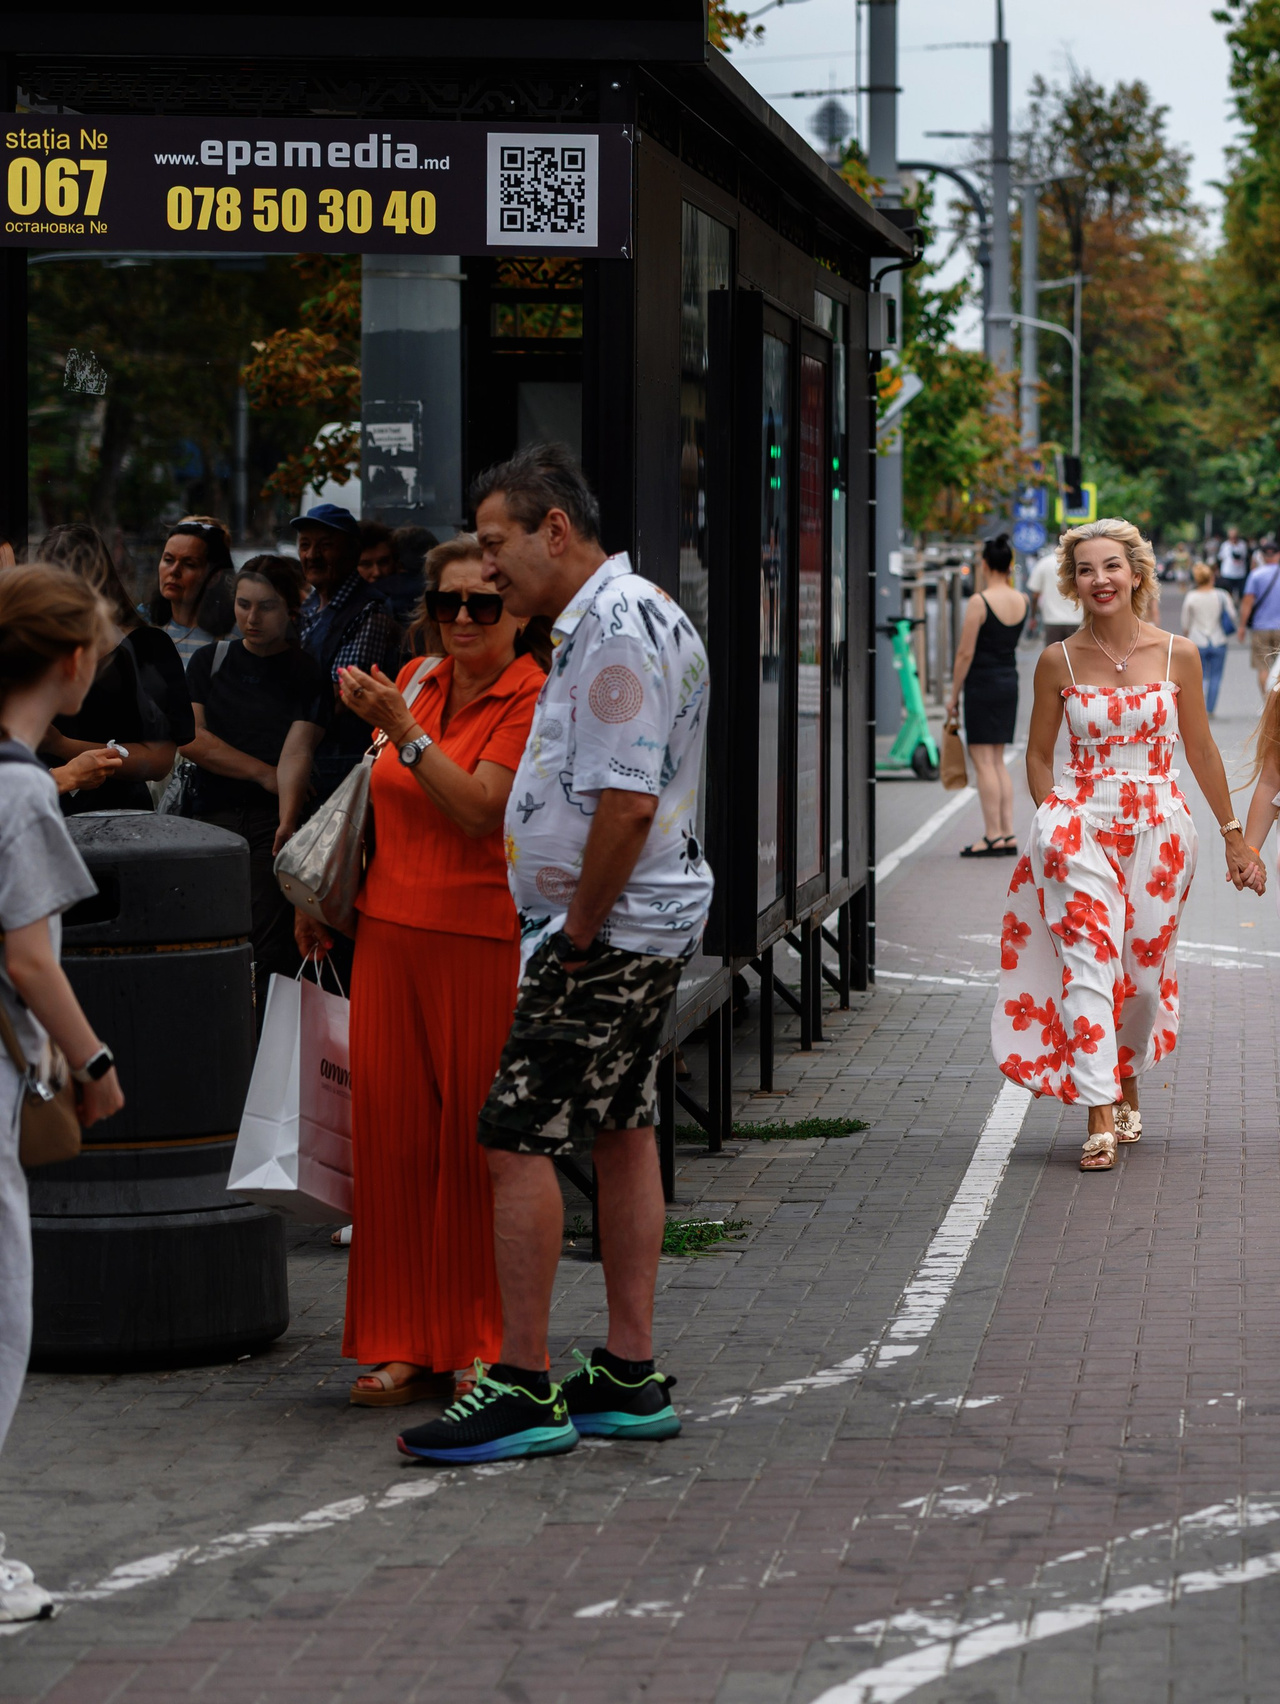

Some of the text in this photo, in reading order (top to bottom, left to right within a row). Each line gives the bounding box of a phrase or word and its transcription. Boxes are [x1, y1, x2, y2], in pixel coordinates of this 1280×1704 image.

[6, 128, 108, 156] stația №
[154, 134, 450, 175] www.epamedia.md
[8, 157, 108, 216] 067
[5, 220, 108, 234] остановка №
[167, 186, 436, 235] 078 50 30 40
